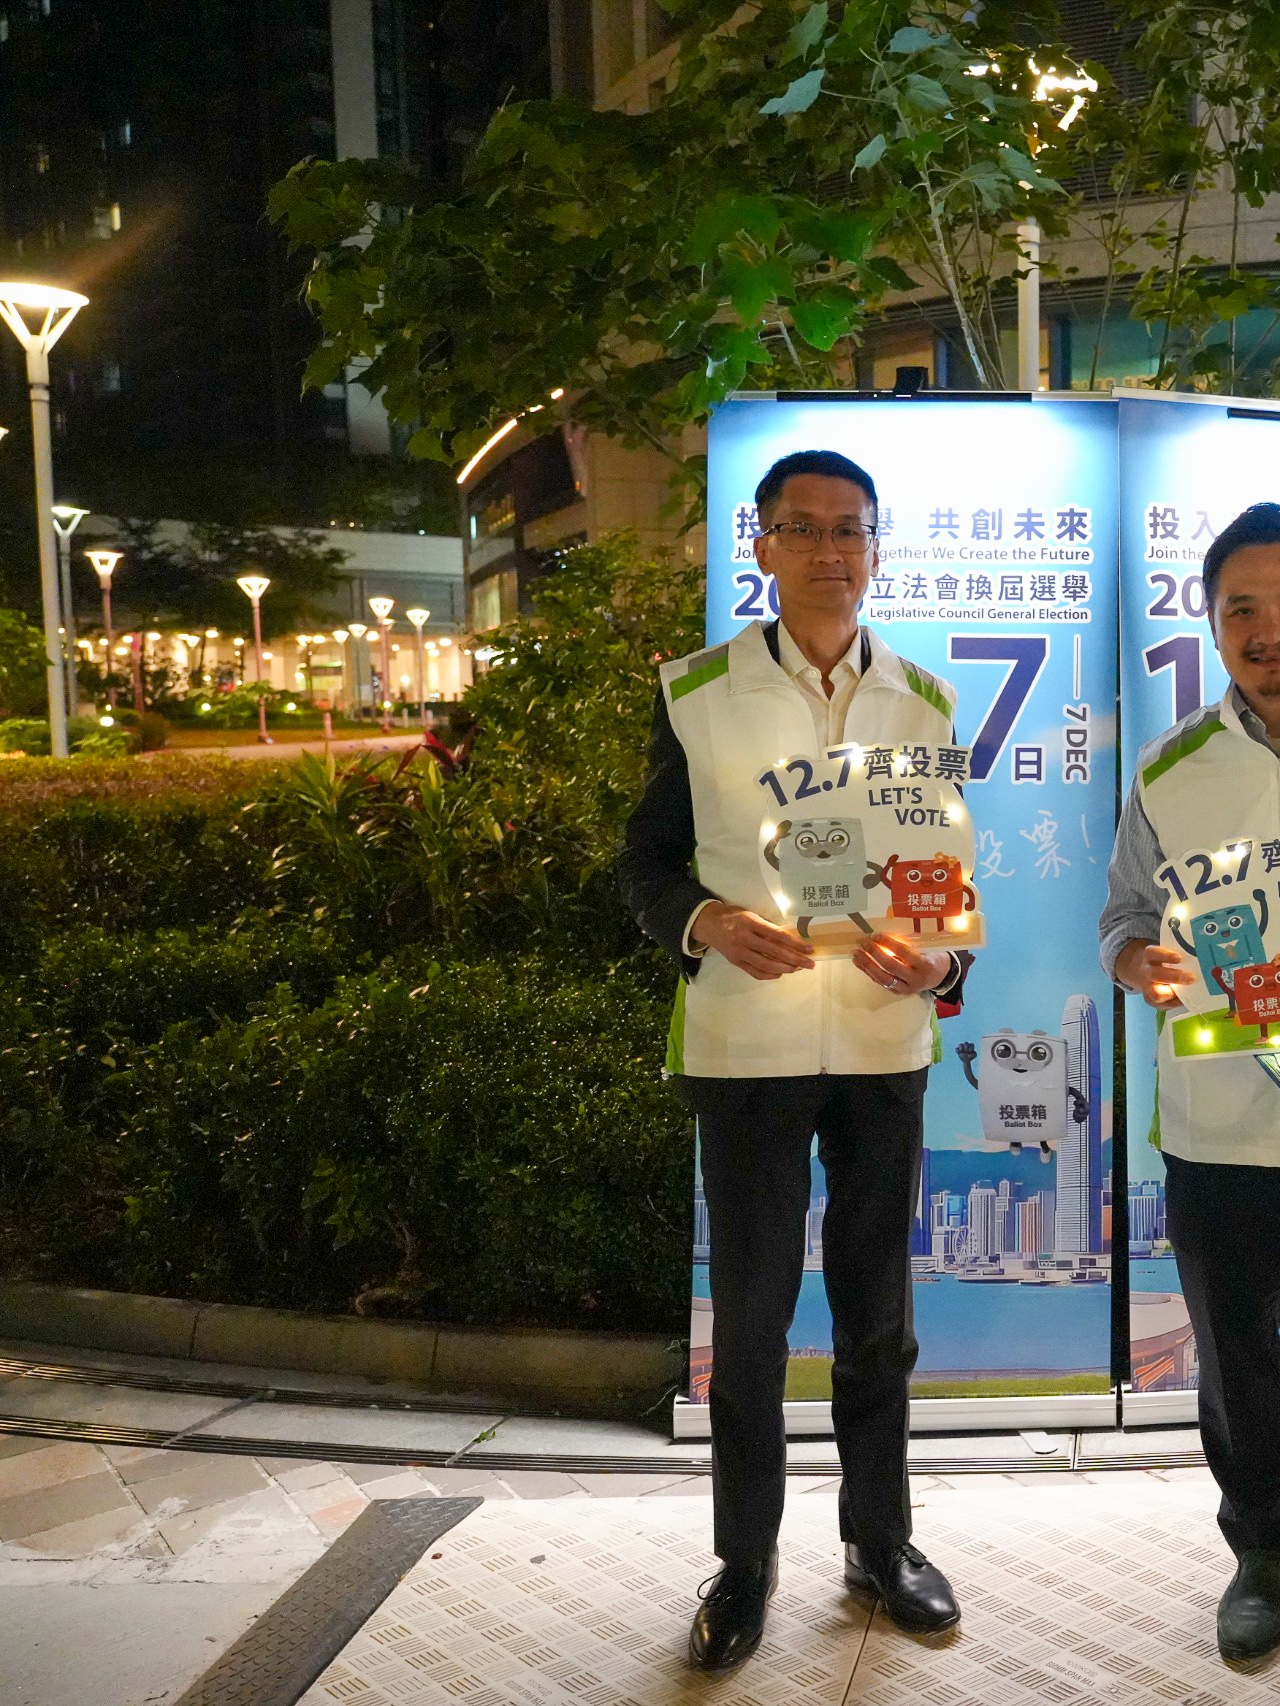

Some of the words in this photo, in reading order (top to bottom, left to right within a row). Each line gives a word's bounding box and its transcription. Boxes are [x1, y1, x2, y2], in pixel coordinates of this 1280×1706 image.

[928, 507, 1089, 541] 共創未來
[932, 547, 955, 560] We
[959, 548, 1006, 560] Create
[1012, 548, 1035, 561] the
[1041, 549, 1090, 561] Future
[1148, 546, 1178, 560] Join
[870, 573, 1089, 602] 立法會換屆選舉
[870, 607, 935, 621] Legislative
[938, 608, 984, 620] Council
[987, 609, 1036, 620] General
[1039, 608, 1088, 620] Election
[1067, 707, 1088, 722] 7
[1066, 729, 1088, 781] DEC
[758, 747, 853, 807] 12.7
[863, 745, 969, 782] 齊投票
[868, 787, 923, 807] LET'S
[895, 808, 951, 828] VOTE
[1159, 840, 1254, 903] 12.7
[802, 884, 850, 901] 投票箱
[907, 893, 946, 906] 投票箱
[999, 1104, 1048, 1121] 投票箱
